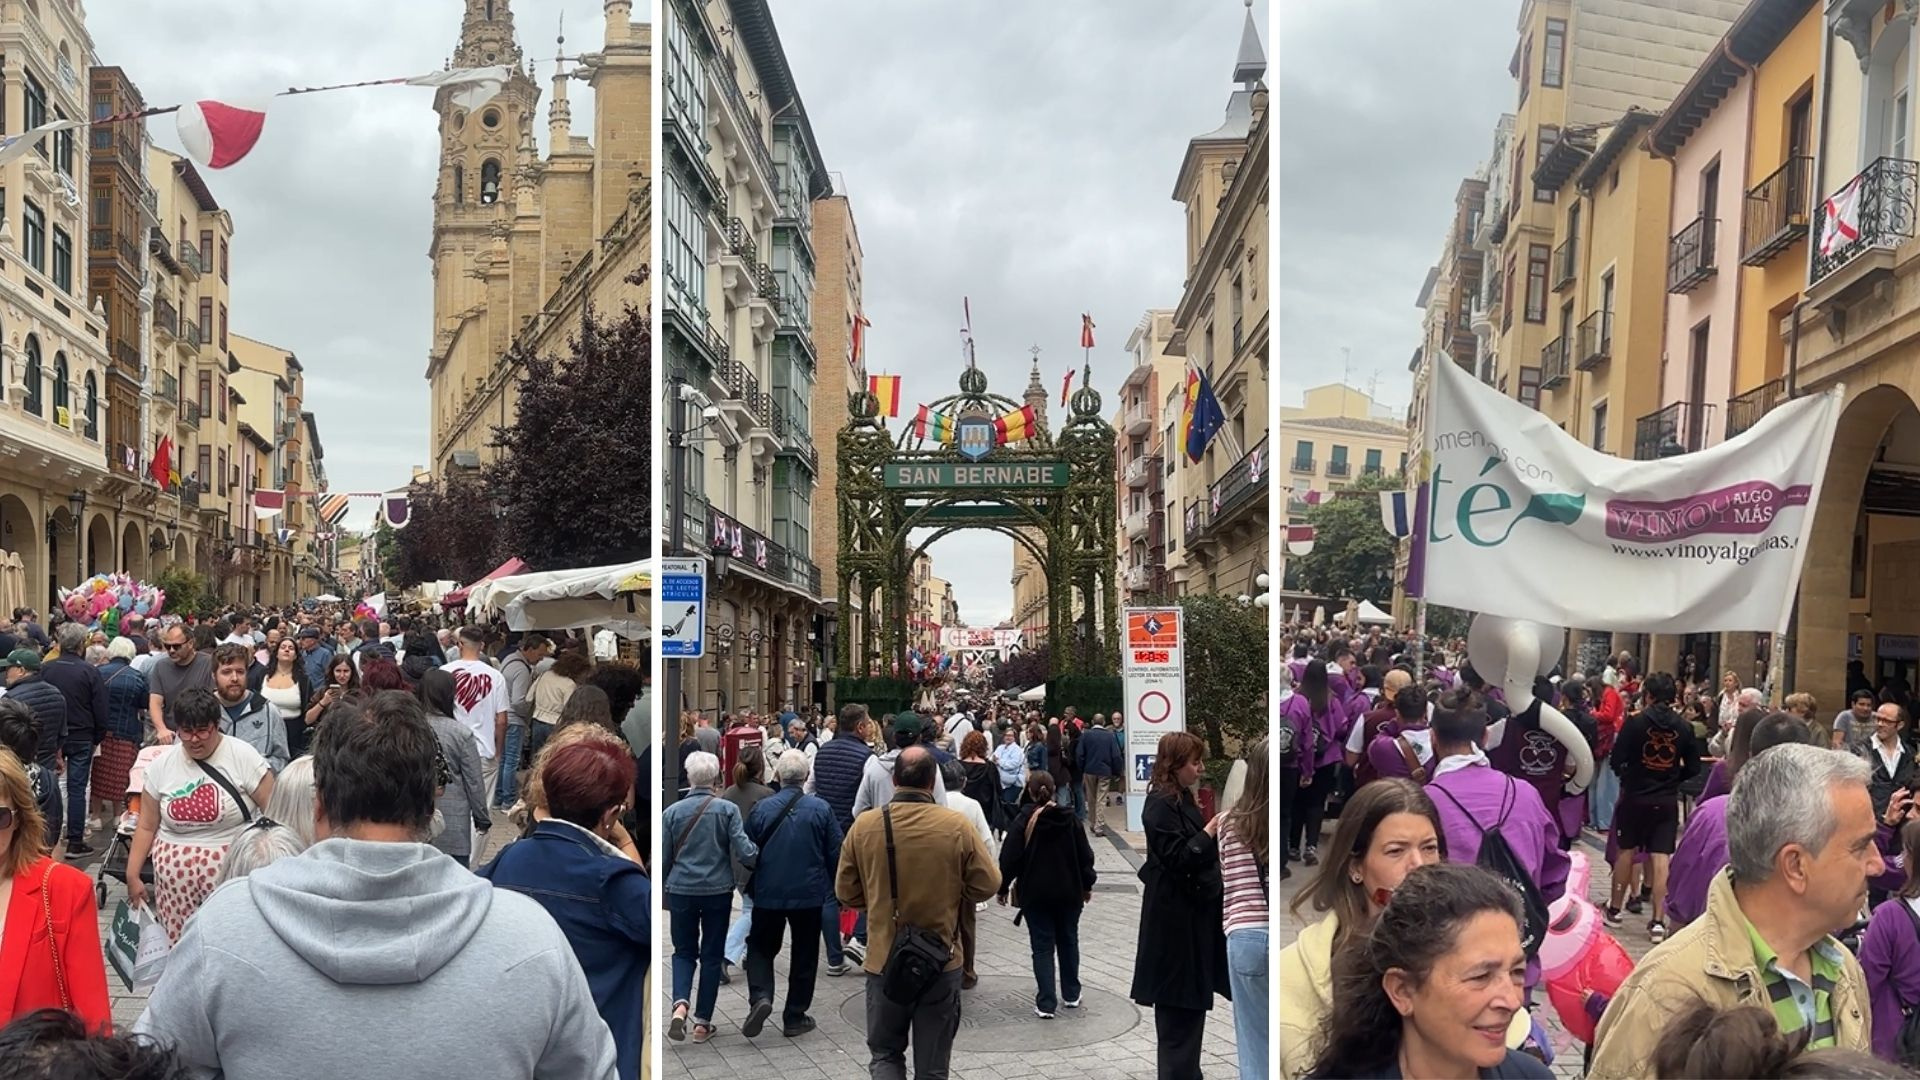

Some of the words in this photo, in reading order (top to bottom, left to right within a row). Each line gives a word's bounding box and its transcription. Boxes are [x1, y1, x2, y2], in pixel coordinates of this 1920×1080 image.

[898, 467, 940, 484] SAN
[954, 466, 1055, 484] BERNABE
[1514, 456, 1554, 483] con
[1733, 488, 1774, 506] ALGO
[1734, 505, 1774, 525] MÁS
